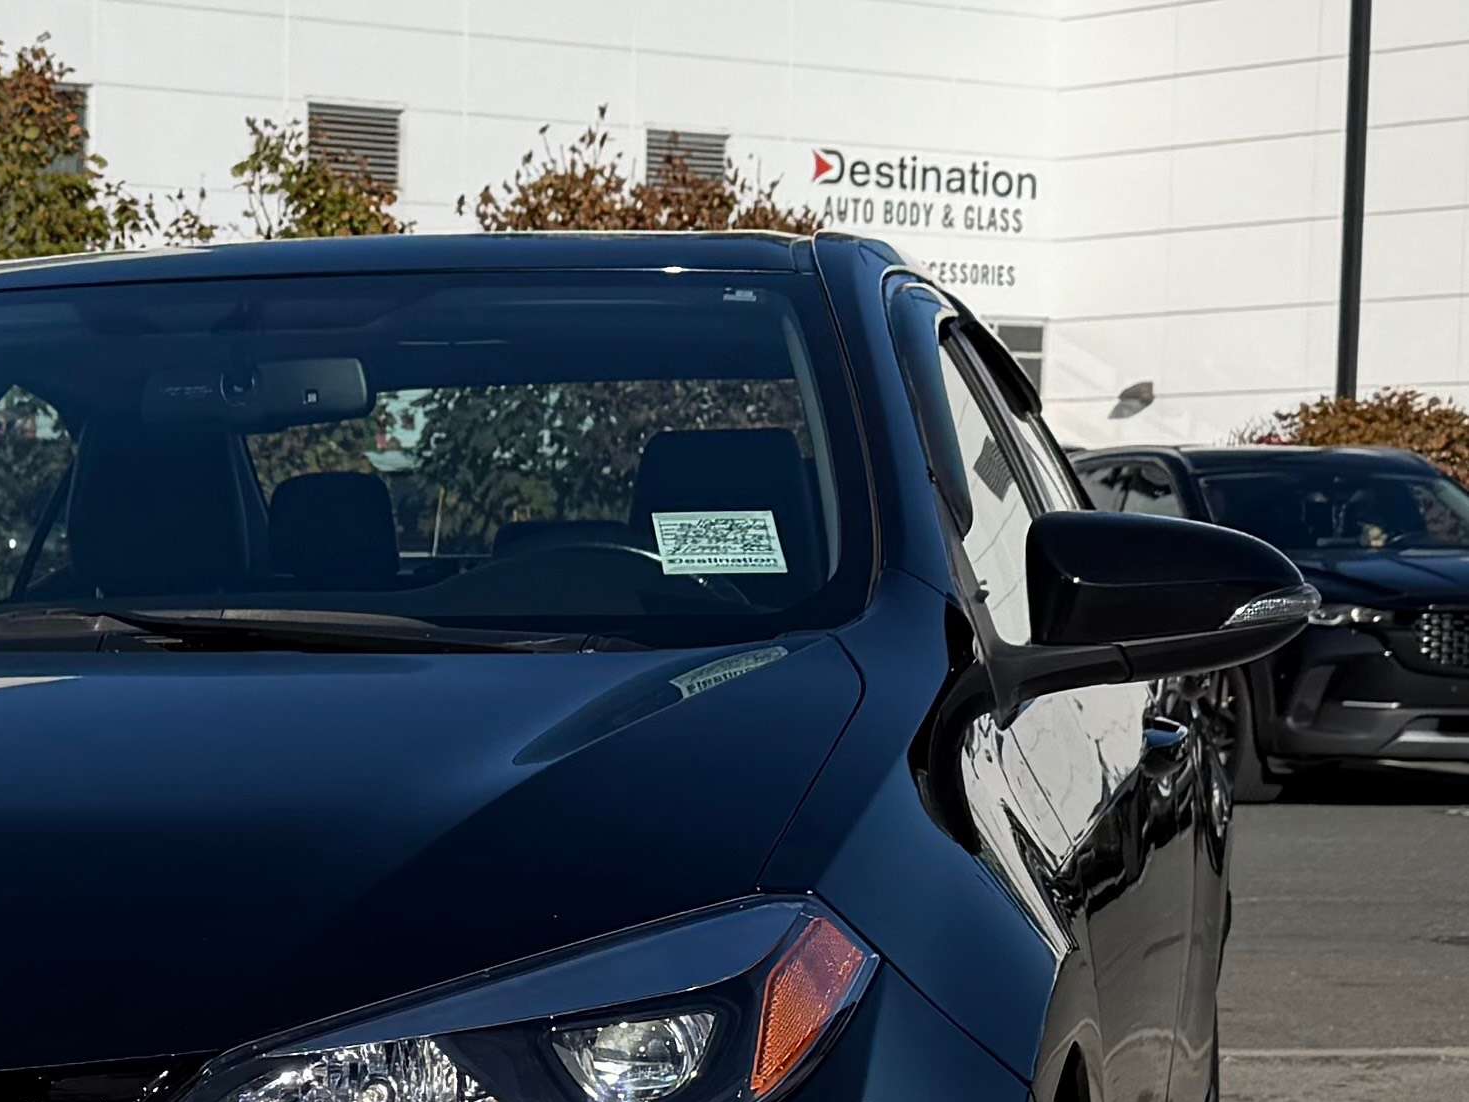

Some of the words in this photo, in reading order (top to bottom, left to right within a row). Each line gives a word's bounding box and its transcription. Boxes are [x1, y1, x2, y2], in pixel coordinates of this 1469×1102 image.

[812, 149, 1037, 200] Destination
[822, 196, 874, 225] AUTO
[883, 200, 933, 228] BODY
[941, 203, 955, 229] &
[964, 206, 1023, 234] GLASS
[922, 261, 1016, 287] ESSORIES
